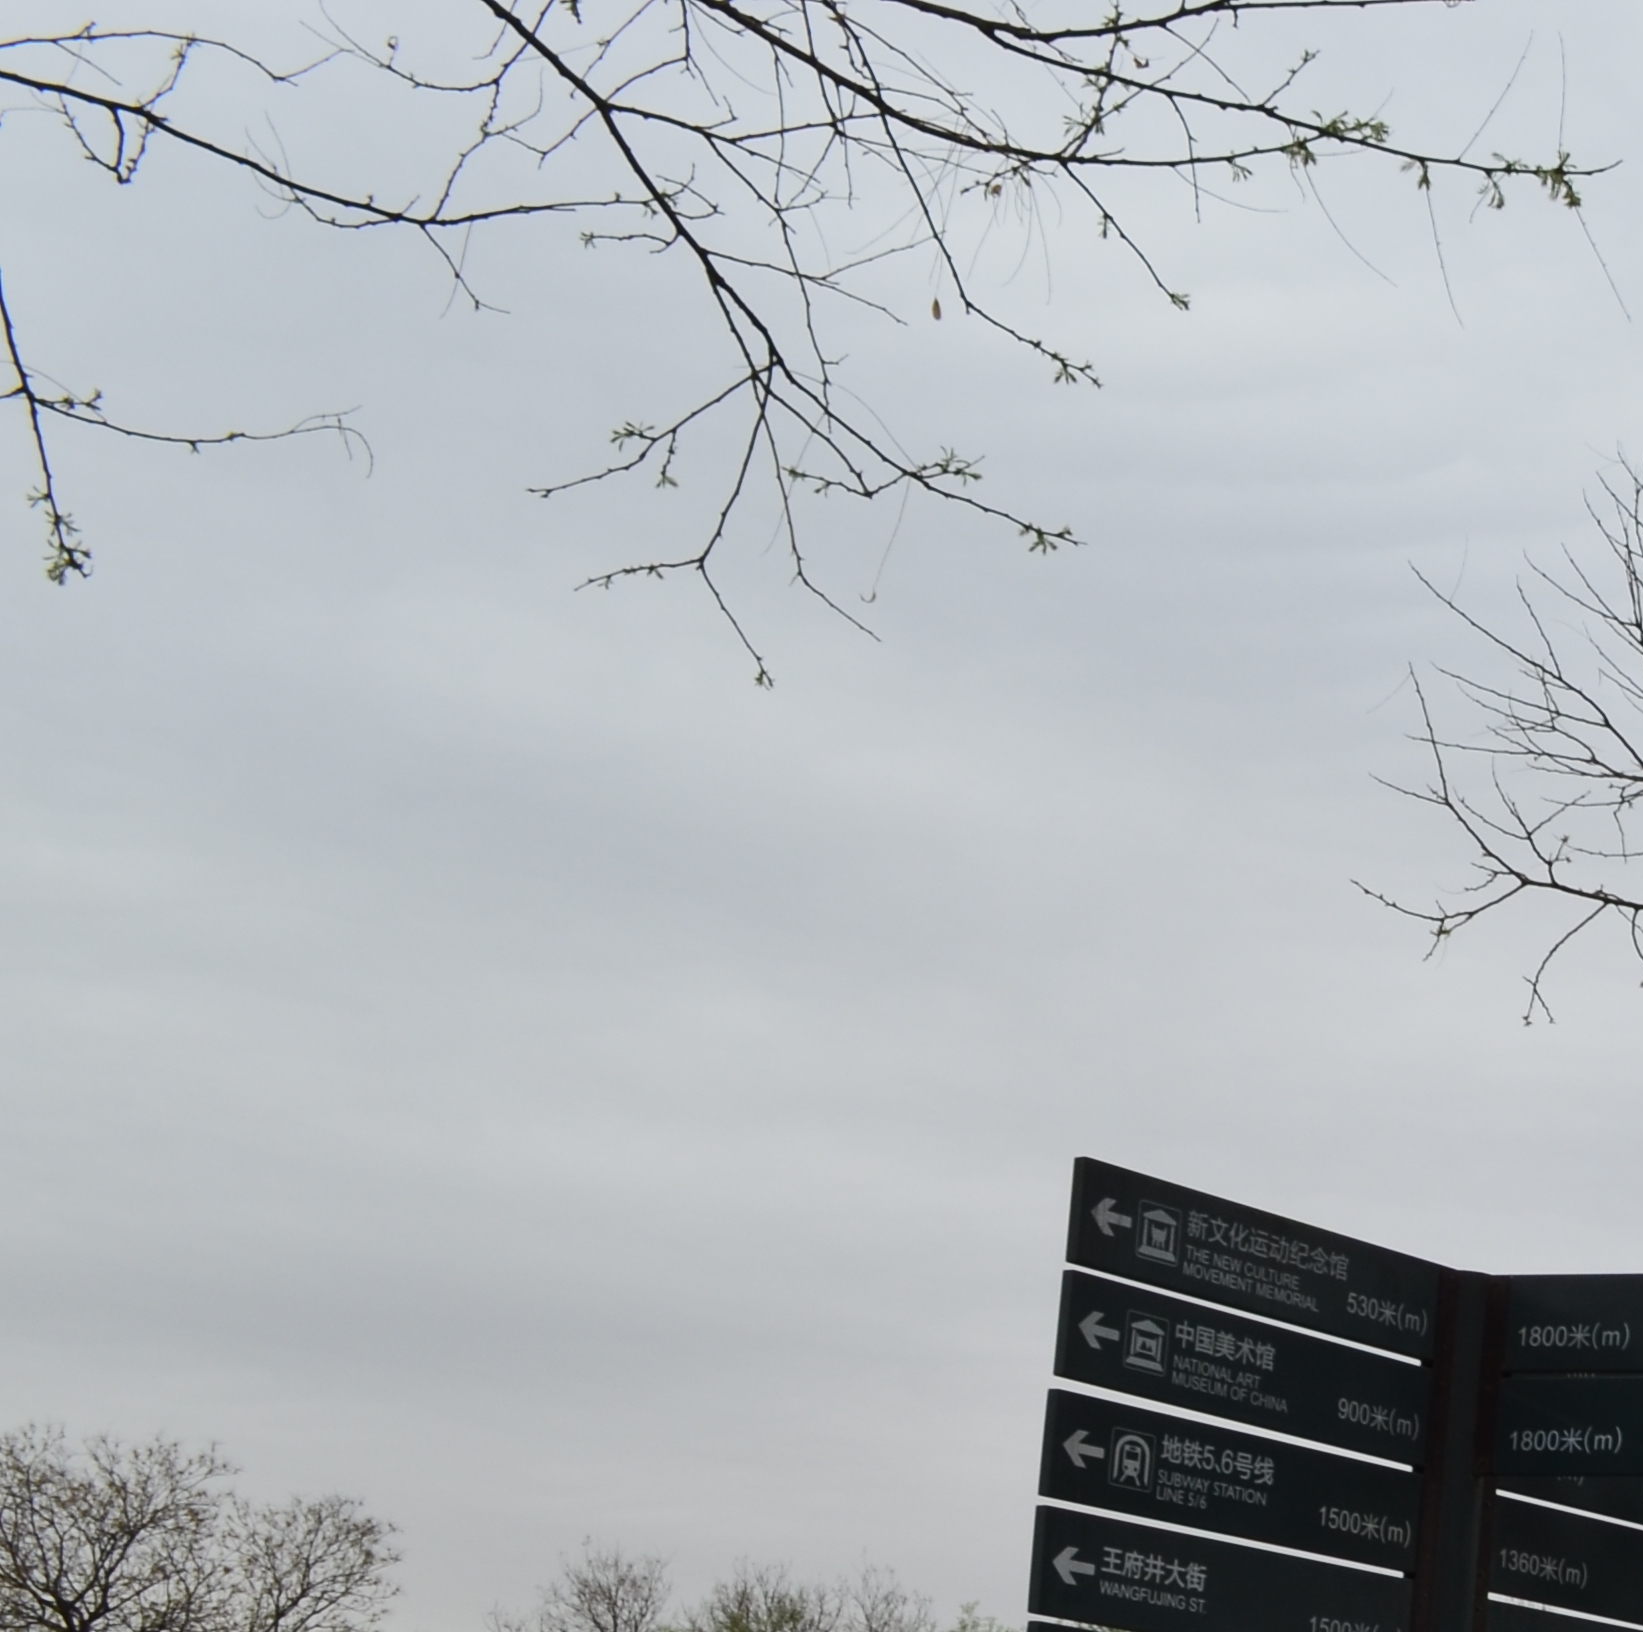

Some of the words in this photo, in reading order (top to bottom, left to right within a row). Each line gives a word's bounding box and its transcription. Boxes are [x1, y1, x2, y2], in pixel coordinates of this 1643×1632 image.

[1184, 1243, 1210, 1265] THE
[1213, 1252, 1241, 1274] NEW
[1244, 1262, 1300, 1290] CULTURE
[1187, 1210, 1350, 1282] 新文化运动纪念馆
[1182, 1261, 1253, 1293] MOVEMENT
[1256, 1280, 1319, 1312] MEMORIAL
[1175, 1320, 1276, 1371] 中国美术馆
[1171, 1371, 1228, 1397] MUSEUM
[1230, 1385, 1248, 1402] OF
[1250, 1391, 1288, 1413] CHINA
[1173, 1355, 1235, 1384] NATIONAL
[1237, 1372, 1261, 1389] ART
[1155, 1486, 1185, 1505] LINE
[1187, 1493, 1207, 1509] 5/6
[1157, 1469, 1211, 1493] SUBWAY
[1213, 1481, 1267, 1506] STATION
[1100, 1546, 1207, 1592] 王府井大街
[1099, 1579, 1186, 1610] WANGFUJING
[1189, 1597, 1207, 1615] ST.
